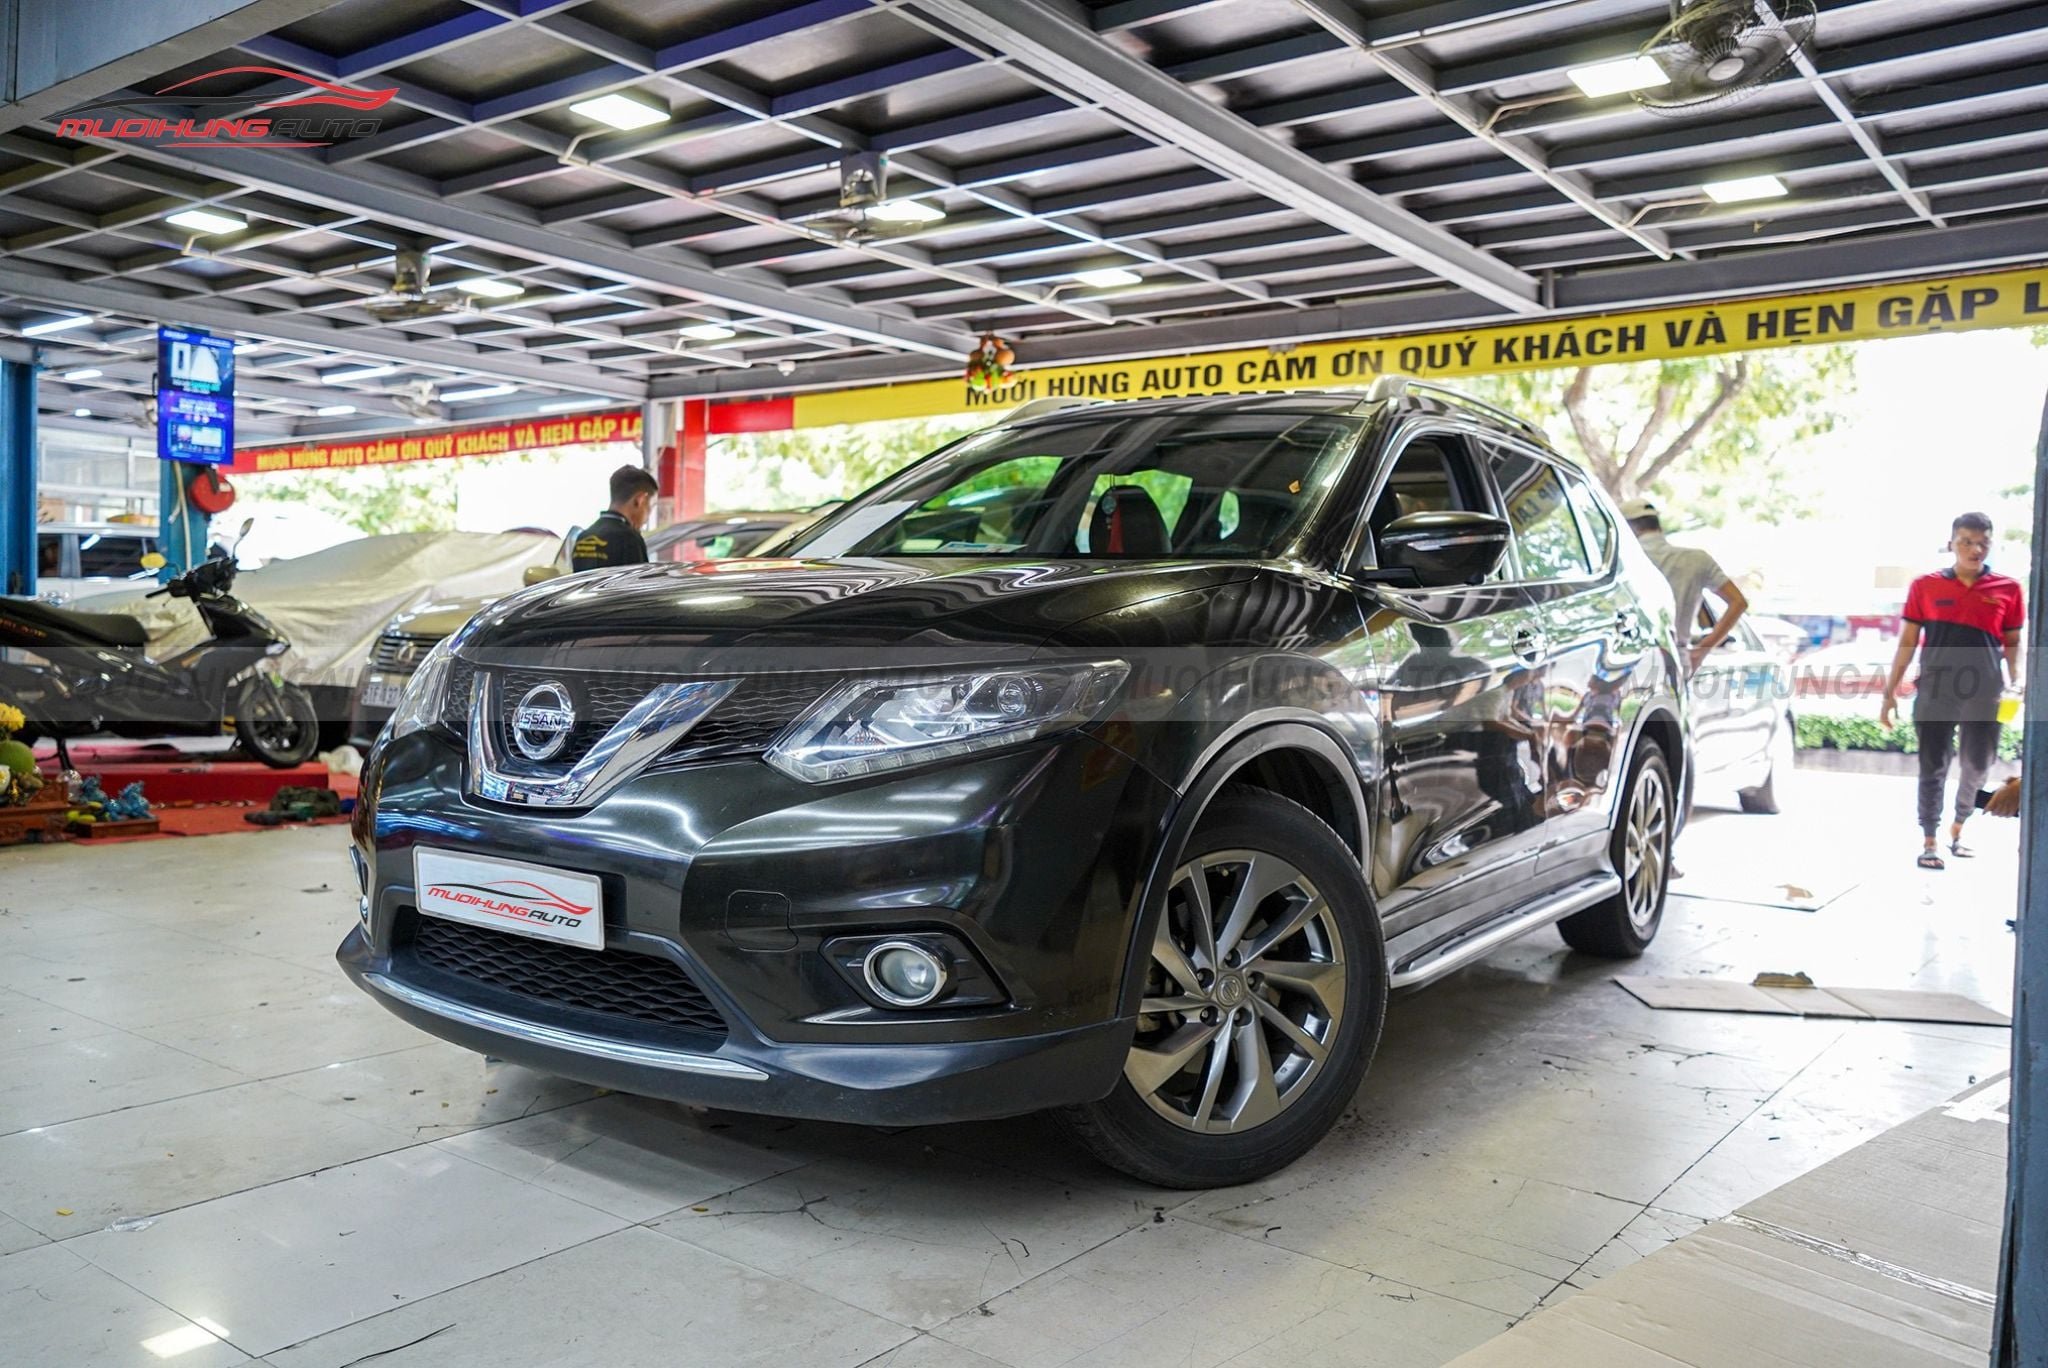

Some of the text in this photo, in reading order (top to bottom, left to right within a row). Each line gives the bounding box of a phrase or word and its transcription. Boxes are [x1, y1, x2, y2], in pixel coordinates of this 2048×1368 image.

[1048, 371, 1130, 397] HÙNG
[1142, 364, 1223, 391] AUTO
[1332, 349, 1384, 377] ƠN
[1400, 336, 1478, 374] QUÝ
[1493, 325, 1646, 364] KHÁCH
[1664, 310, 1727, 349] VÀ
[1747, 301, 1856, 343] HẸN
[1878, 284, 2000, 331] GẶP
[2024, 281, 2048, 314] L
[330, 446, 364, 467] AUTO
[456, 430, 510, 455] KHÁCH
[514, 424, 537, 449] VÀ
[540, 422, 575, 447] HẸN
[579, 415, 618, 443] GẶP
[621, 416, 643, 442] LẠ
